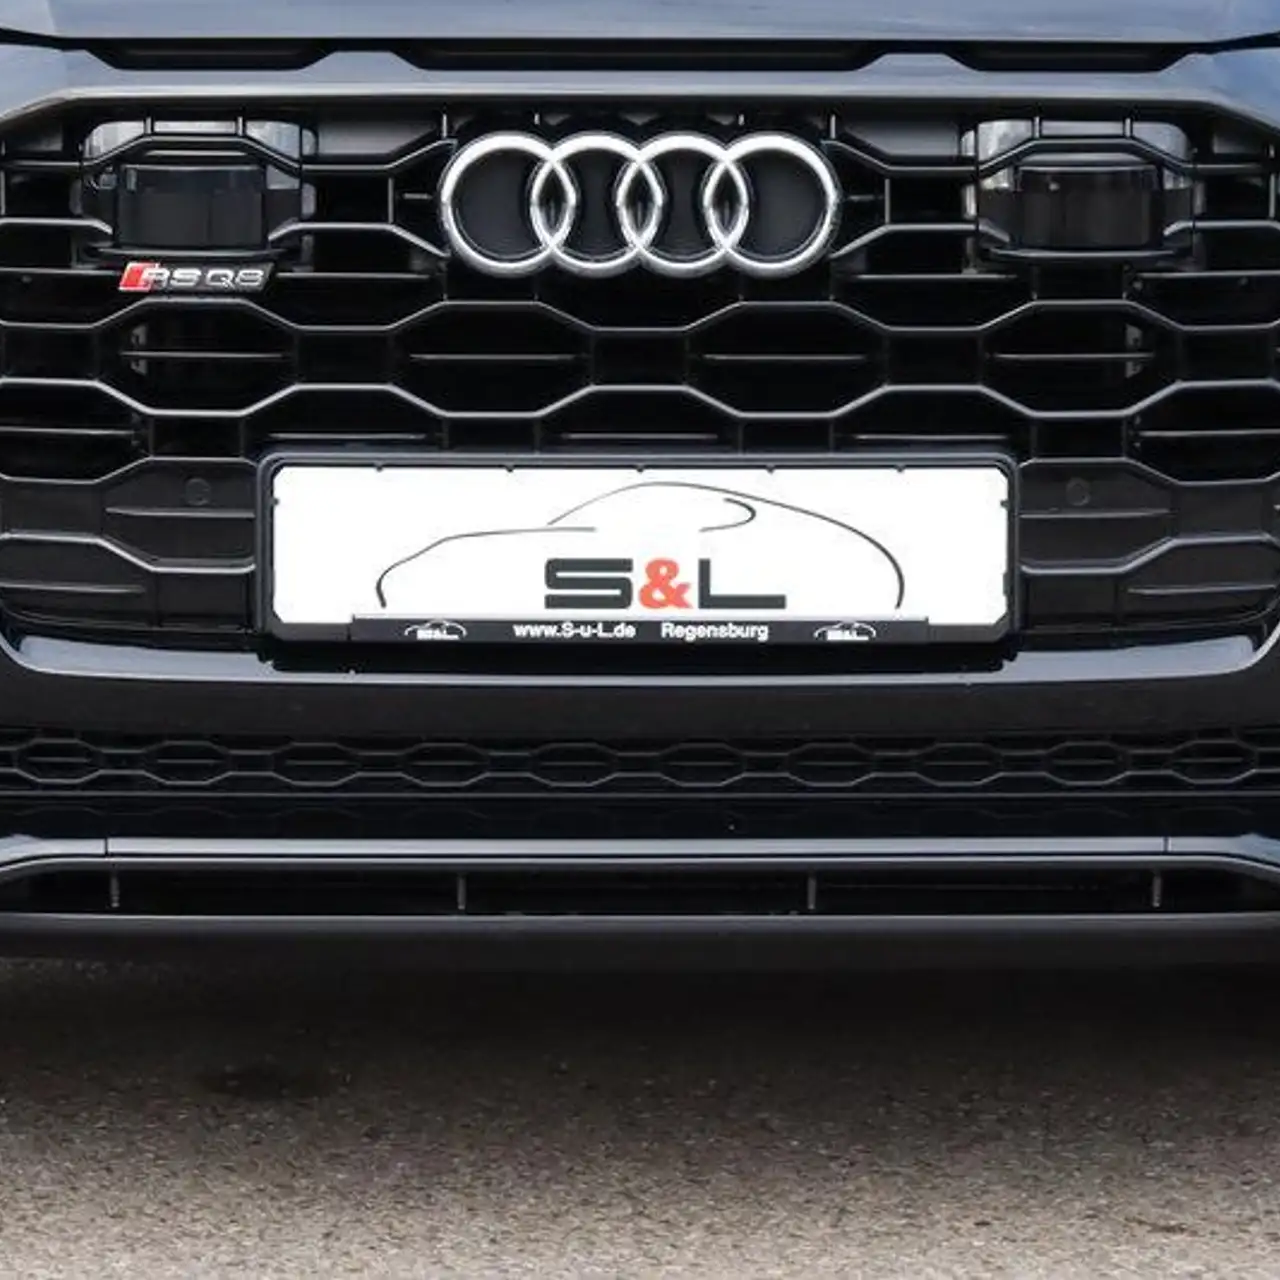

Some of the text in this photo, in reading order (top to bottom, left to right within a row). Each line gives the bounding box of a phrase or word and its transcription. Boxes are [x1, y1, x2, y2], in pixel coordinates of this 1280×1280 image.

[544, 557, 786, 609] S&L
[513, 622, 769, 642] www.S-u-L.de Regensburg
